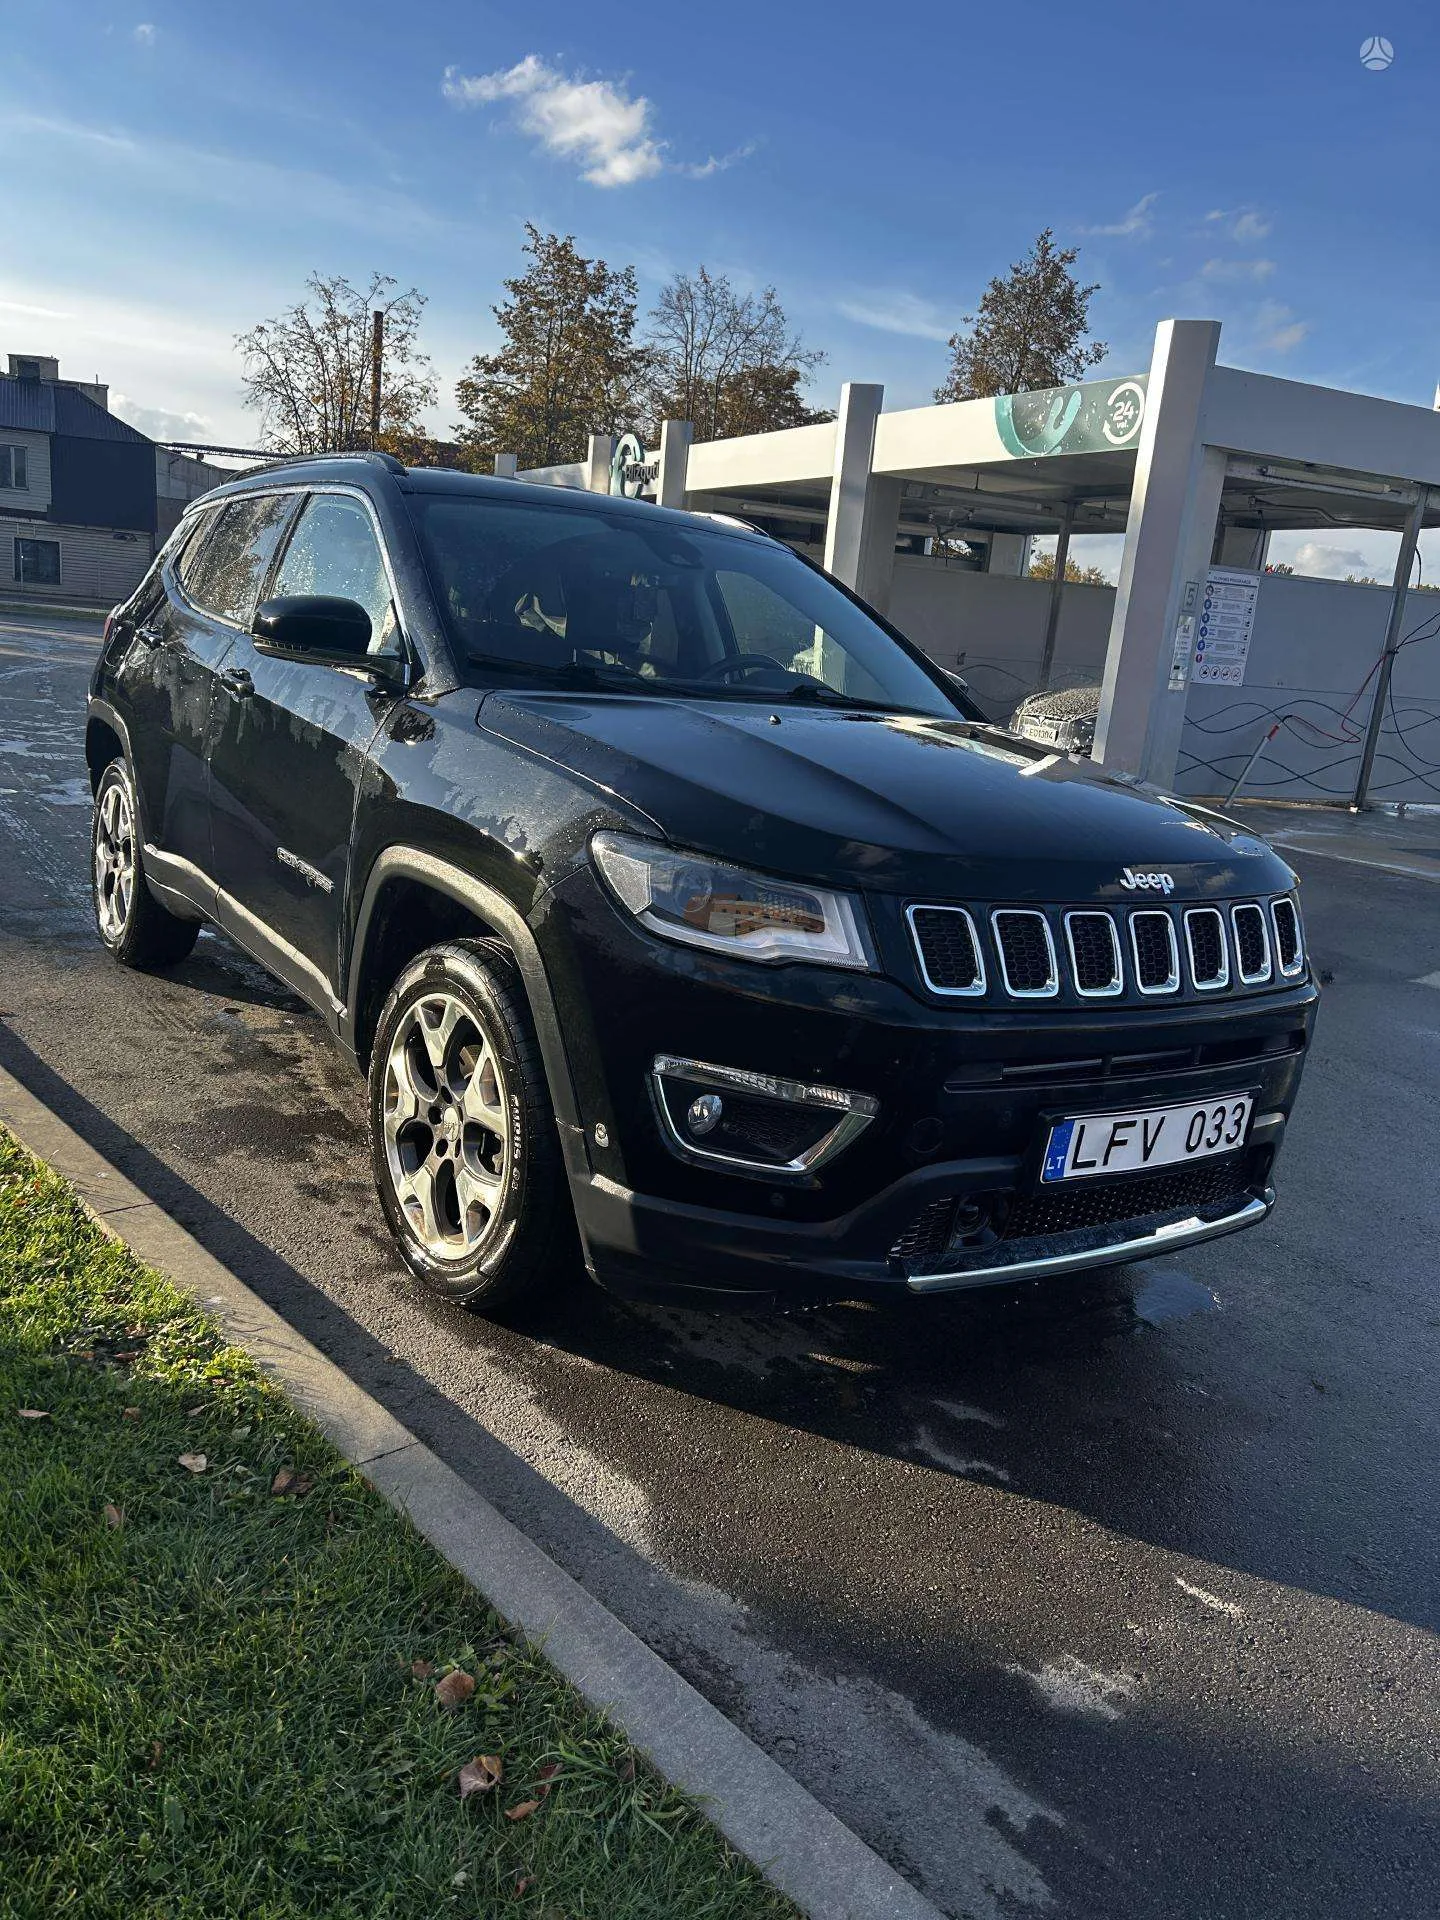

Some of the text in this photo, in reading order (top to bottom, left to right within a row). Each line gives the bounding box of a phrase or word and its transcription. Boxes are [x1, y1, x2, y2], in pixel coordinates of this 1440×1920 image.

[1113, 401, 1134, 421] 24
[1186, 588, 1196, 606] 5
[1119, 867, 1175, 895] Jeep
[1071, 1101, 1247, 1170] LFV 033
[1046, 1155, 1065, 1170] LT
